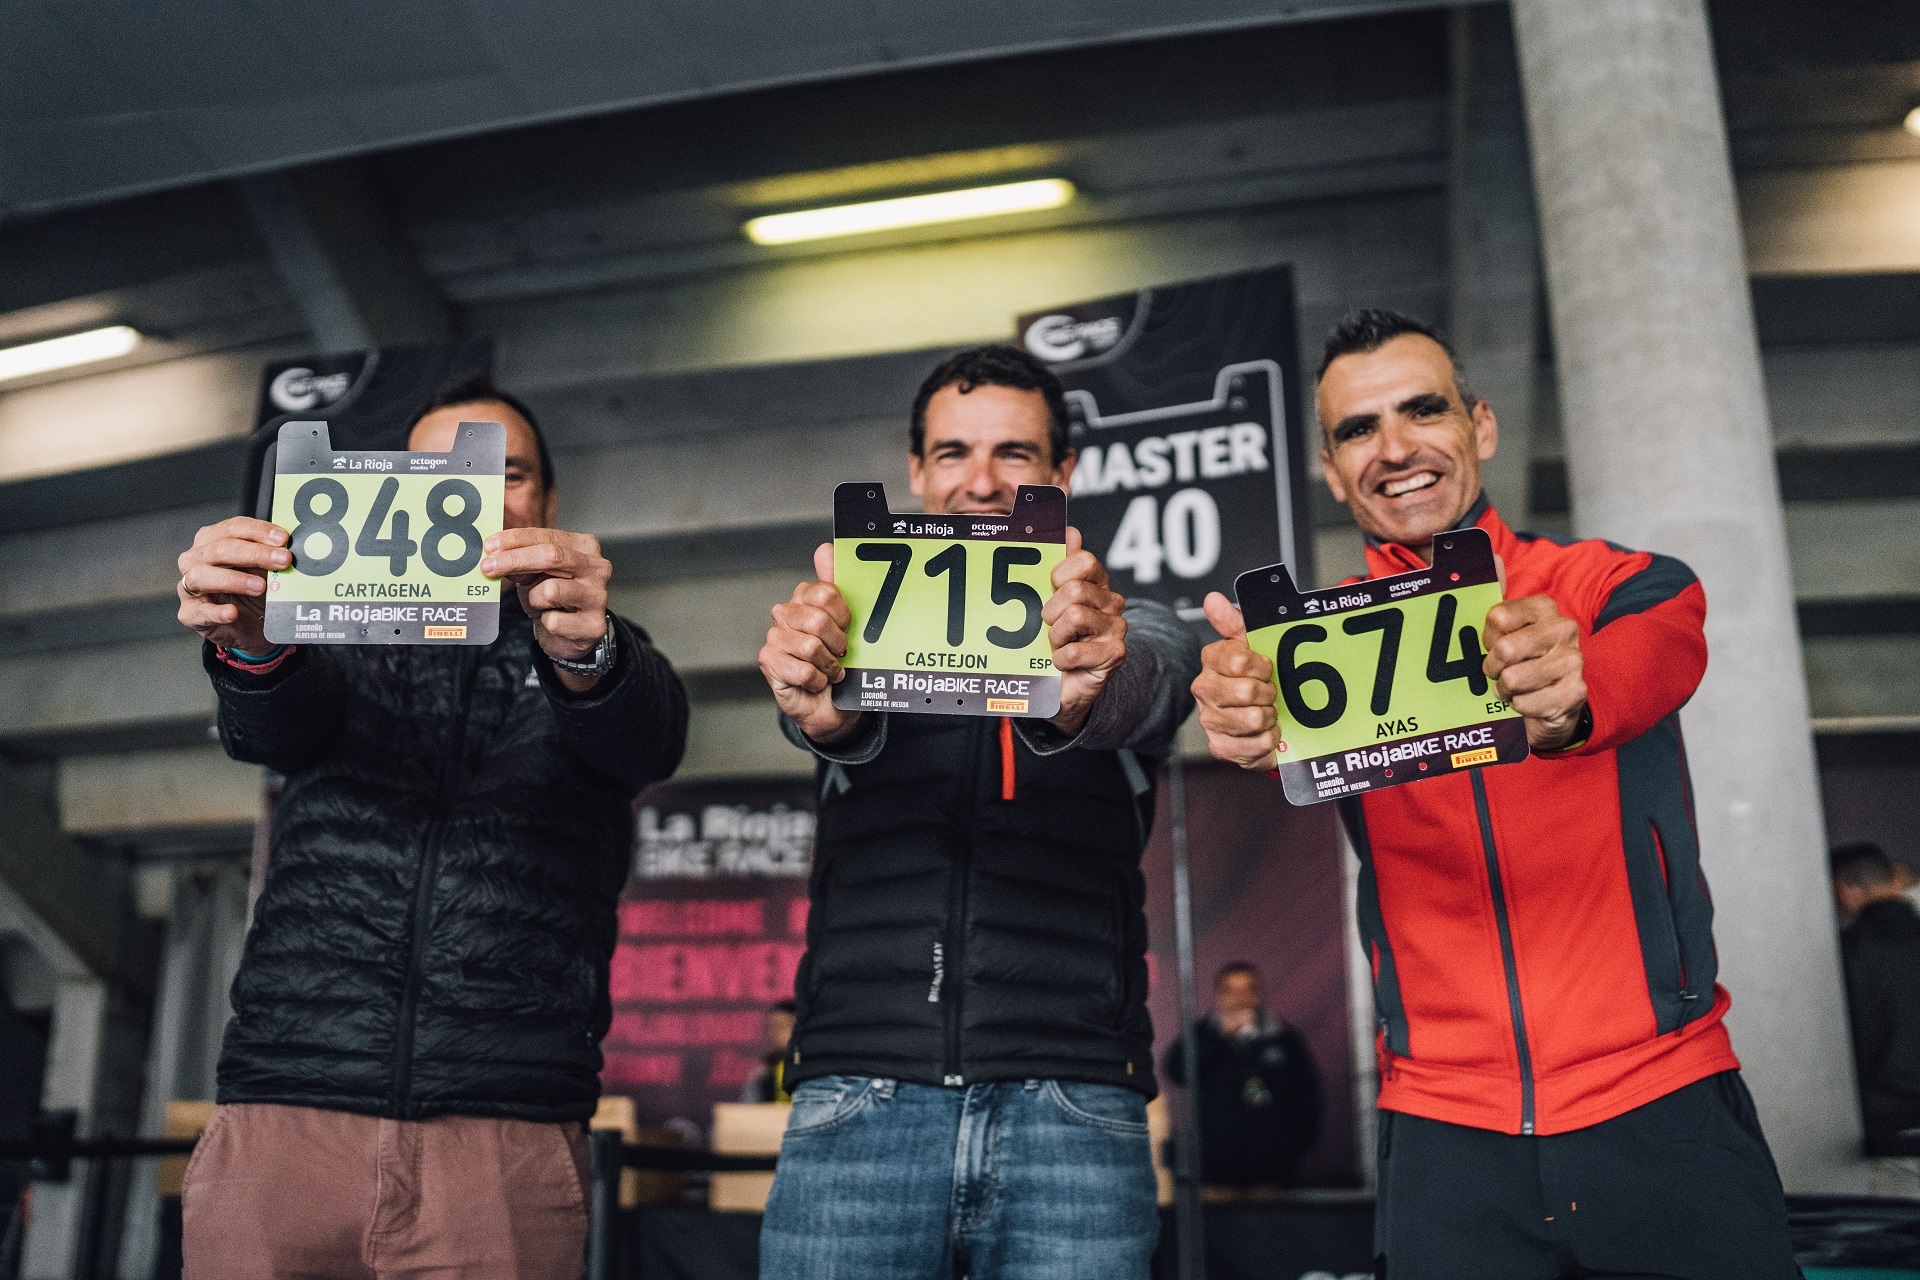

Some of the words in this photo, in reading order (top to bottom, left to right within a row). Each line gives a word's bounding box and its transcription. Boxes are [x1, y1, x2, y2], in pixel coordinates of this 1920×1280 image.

[350, 459, 362, 470] La
[364, 459, 393, 472] Rioja
[410, 458, 448, 469] octagon
[289, 476, 484, 578] 848
[910, 524, 922, 534] La
[925, 523, 954, 536] Rioja
[971, 523, 1008, 536] octagon
[1106, 488, 1221, 584] 40
[334, 582, 432, 598] CARTAGENA
[466, 586, 490, 596] ESP
[1388, 578, 1431, 592] octagon
[855, 542, 1044, 650] 715
[1322, 599, 1339, 612] La
[1340, 592, 1372, 608] Rioja
[296, 604, 321, 621] La
[422, 607, 468, 622] RACE
[428, 628, 464, 637] PIRELLI
[905, 652, 988, 670] CASTEJON
[1029, 658, 1052, 670] ESP
[1276, 593, 1489, 729] 674
[862, 672, 886, 689] La
[984, 679, 1030, 696] RACE
[990, 700, 1025, 710] PIRELLI
[1376, 716, 1419, 738] AYAS
[1310, 760, 1340, 779] La
[1444, 727, 1494, 751] RACE
[1455, 750, 1493, 765] PIRELLI
[1316, 776, 1345, 790] LOGROÑO
[1342, 784, 1350, 793] DE
